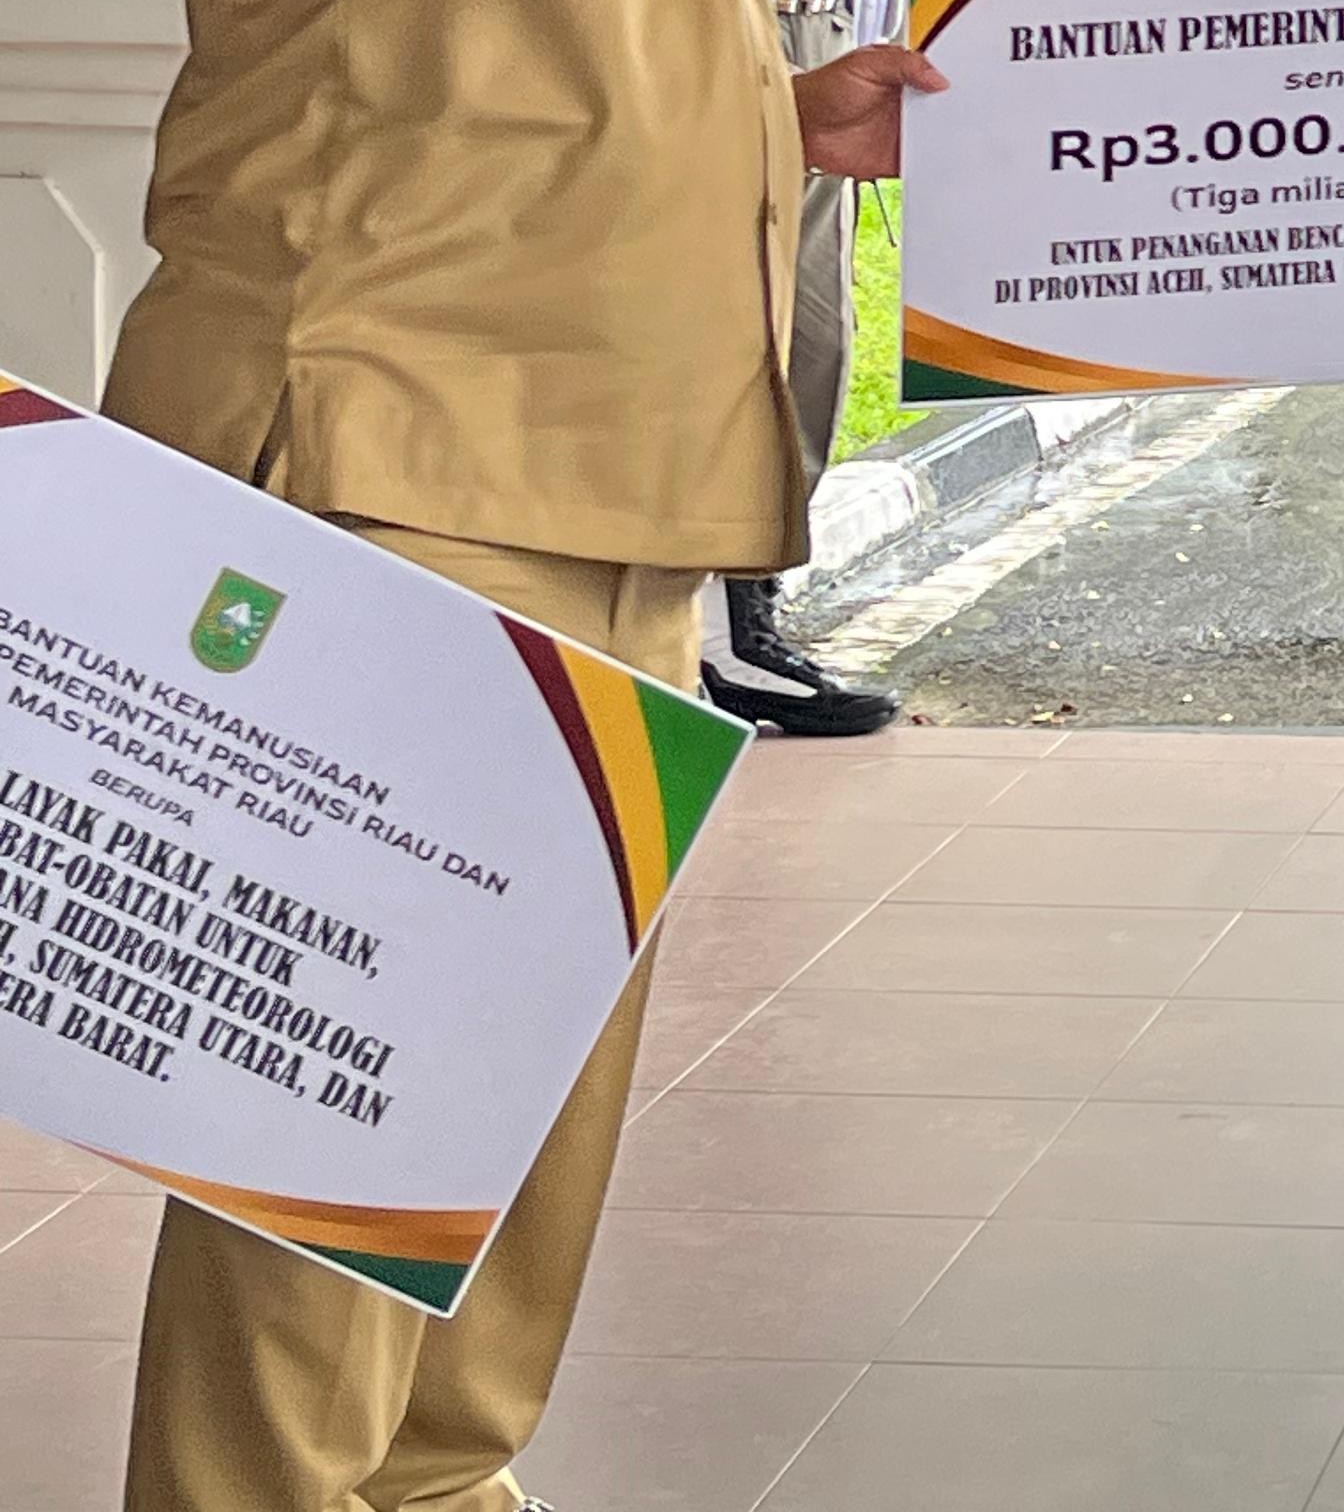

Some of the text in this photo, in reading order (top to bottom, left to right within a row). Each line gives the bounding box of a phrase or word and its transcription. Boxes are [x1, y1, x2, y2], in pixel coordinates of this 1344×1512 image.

[1009, 18, 1166, 61] BANTUAN
[1171, 183, 1260, 214] (Tiga
[994, 278, 1022, 304] DI
[1028, 272, 1140, 302] PROVINSI
[1147, 268, 1213, 295] ACEH,
[1221, 259, 1336, 290] SUMATERA
[1050, 239, 1123, 265] UNTUK
[1131, 228, 1279, 261] PENANGANAN
[0, 607, 391, 806] BANTUAN KEMANUSIAAN
[7, 686, 315, 838] MASYARAKAT RIAU
[89, 769, 195, 826] BERUPA
[208, 744, 359, 826] PROVINSI
[362, 815, 439, 861] RIAU
[441, 853, 511, 896] DAN
[0, 769, 382, 979] LAYAK PAKAI, MAKANAN,
[51, 898, 396, 1079] HIDROMETEOROLOGI
[195, 911, 304, 987] UNTUK
[30, 938, 193, 1040] SUMATERA
[198, 1015, 306, 1098] UTARA,
[317, 1069, 395, 1128] DAN
[57, 1002, 176, 1083] BARAT.
